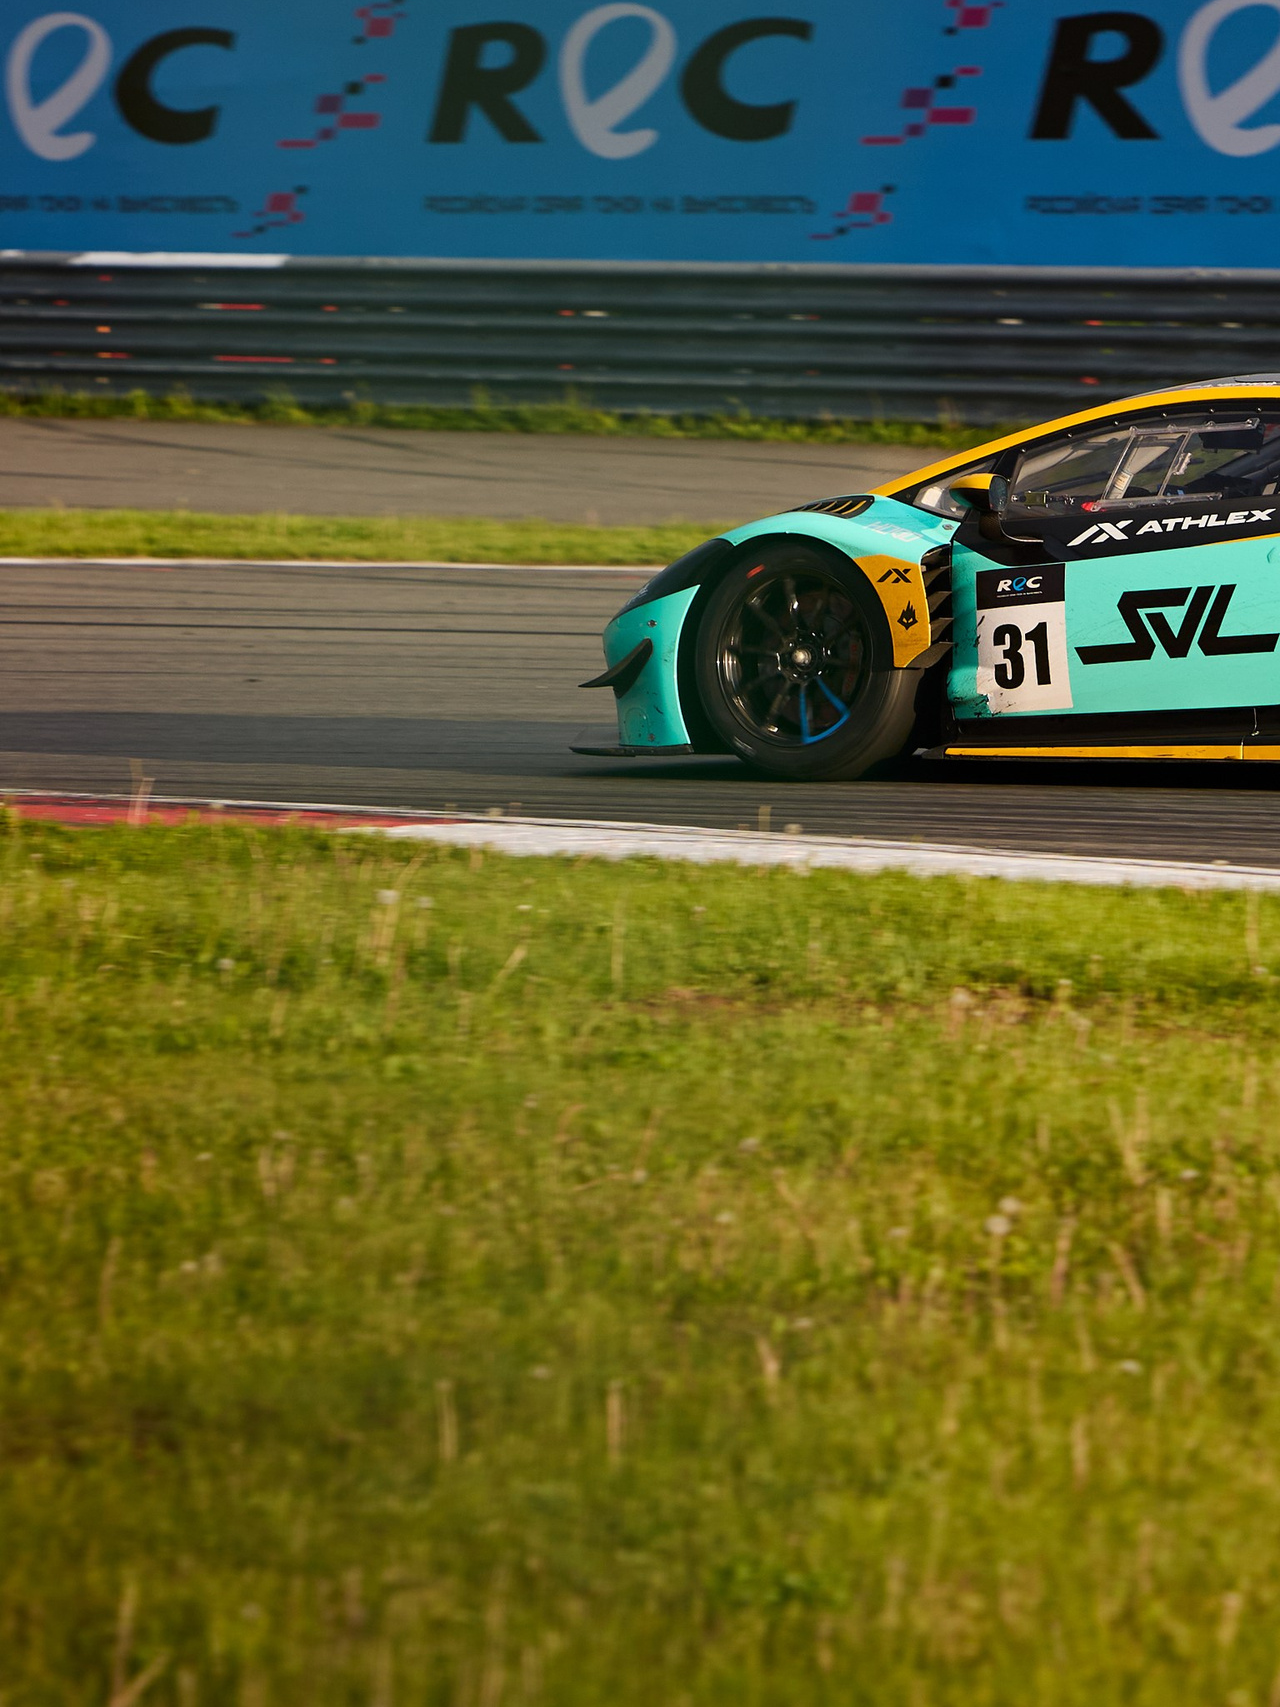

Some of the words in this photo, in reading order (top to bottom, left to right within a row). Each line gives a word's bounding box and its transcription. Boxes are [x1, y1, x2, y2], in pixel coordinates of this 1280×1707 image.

[1136, 508, 1277, 536] ATHLEX
[993, 621, 1052, 691] 31
[1074, 584, 1280, 666] SVL
